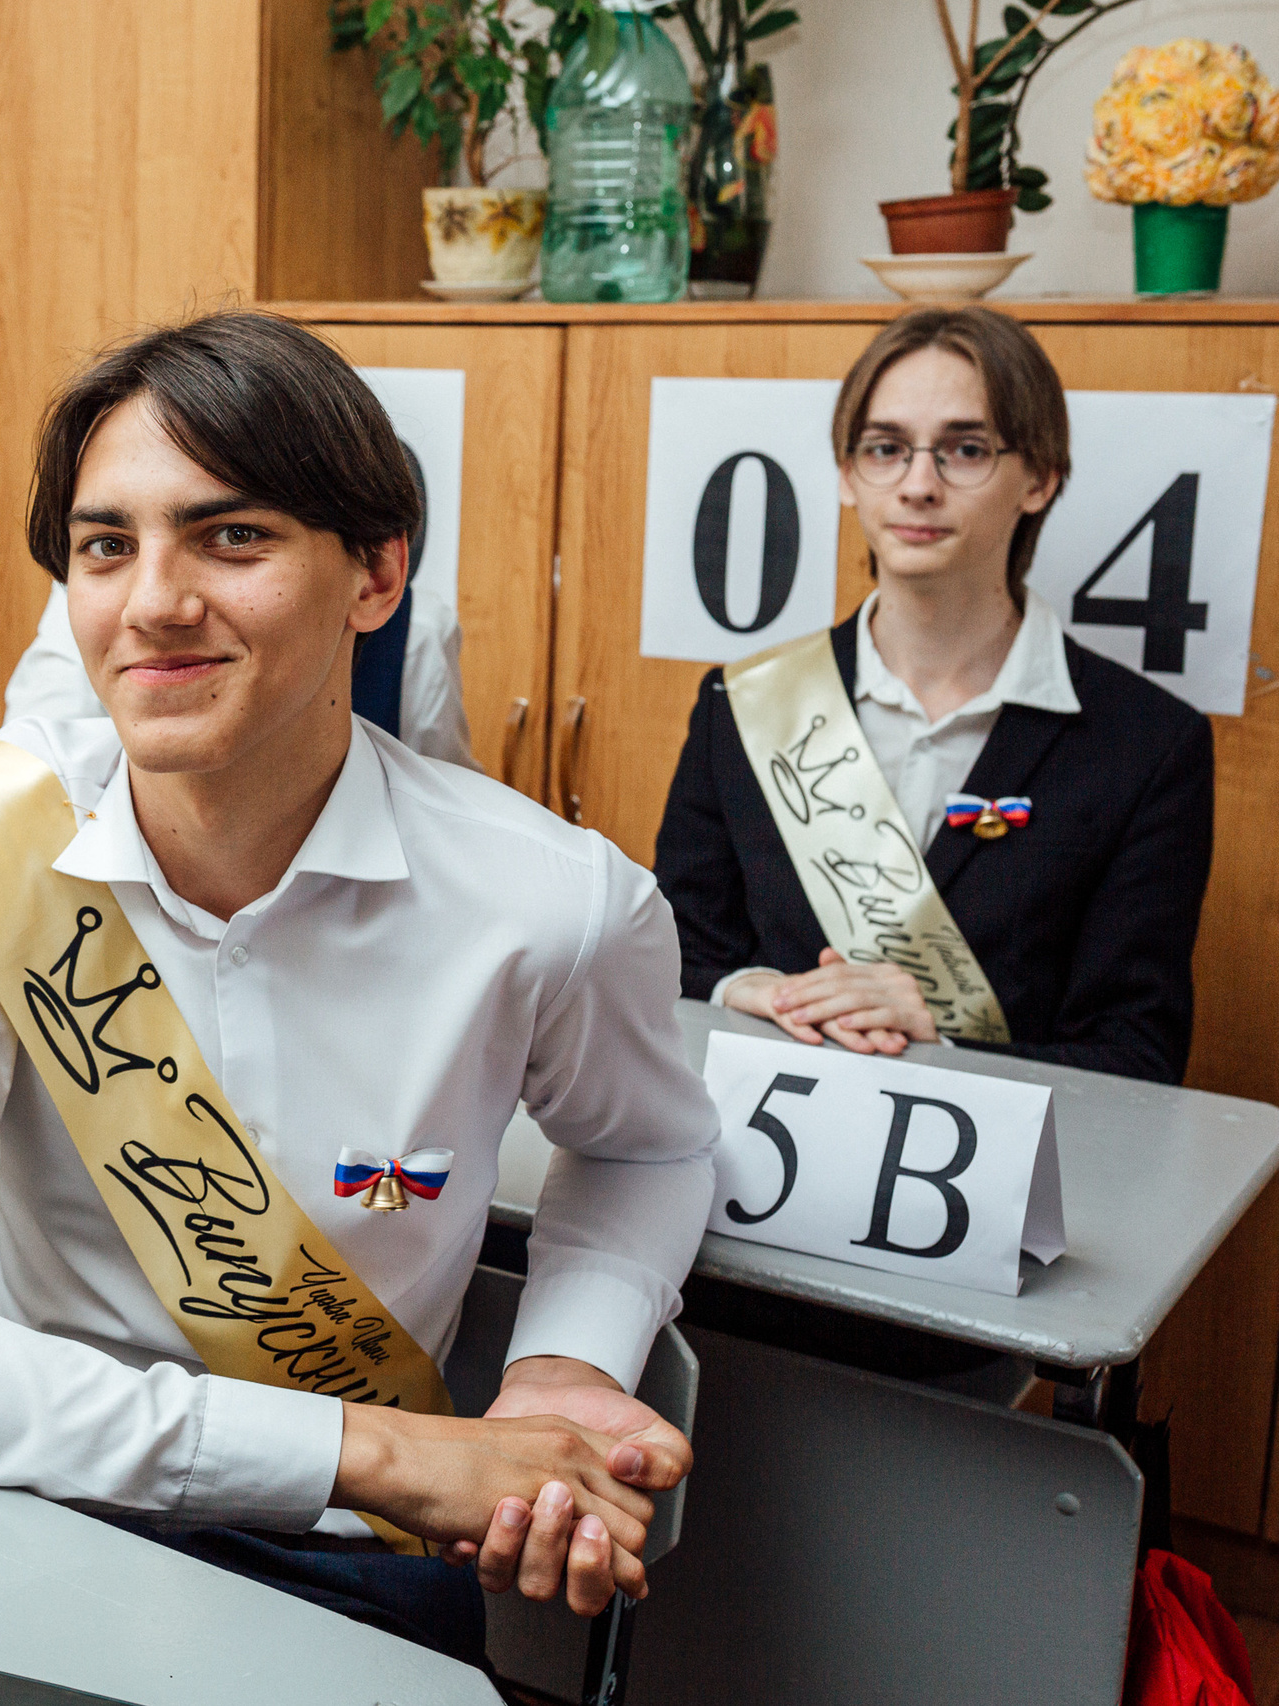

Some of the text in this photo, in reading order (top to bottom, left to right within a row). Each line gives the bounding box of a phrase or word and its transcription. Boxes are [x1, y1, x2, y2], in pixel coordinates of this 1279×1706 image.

[693, 450, 1208, 674] 0 4
[726, 1072, 819, 1225] 5
[121, 1093, 400, 1408] Выпускни
[352, 1316, 392, 1366] Иван
